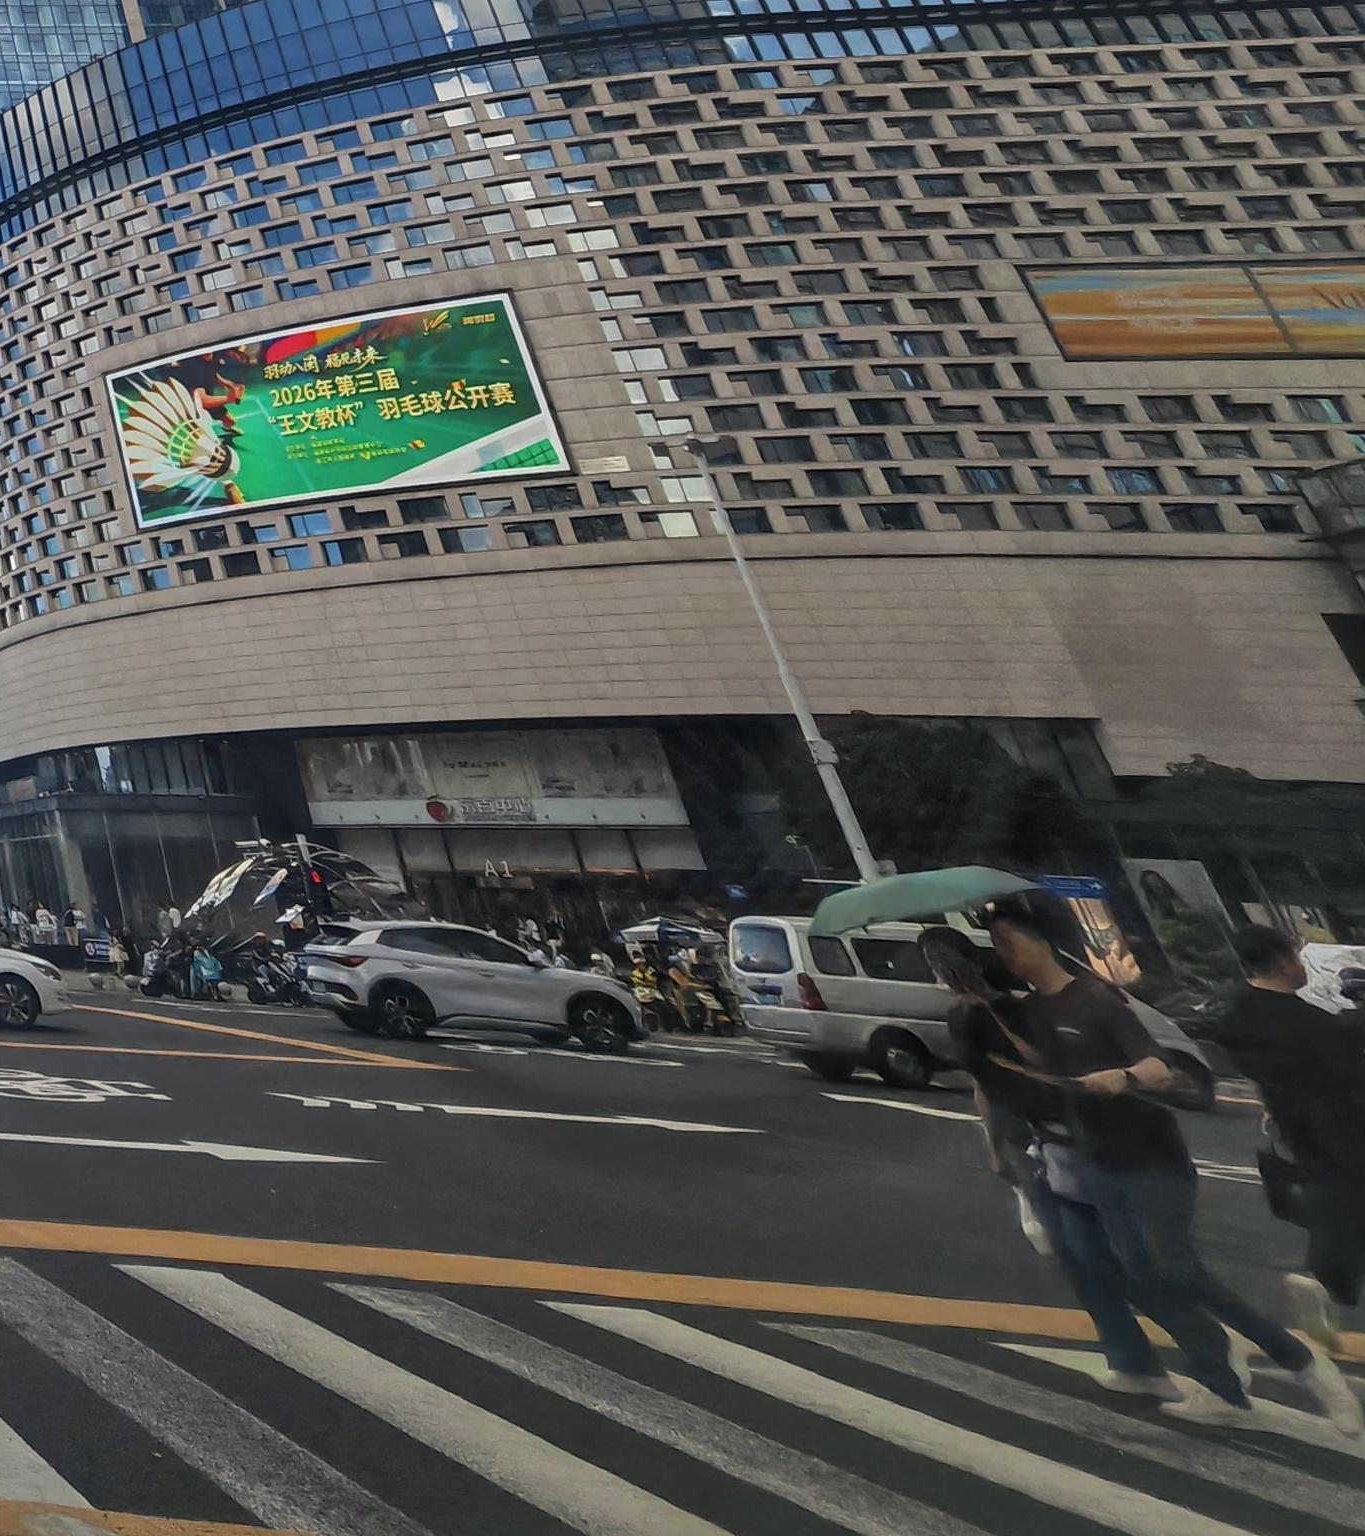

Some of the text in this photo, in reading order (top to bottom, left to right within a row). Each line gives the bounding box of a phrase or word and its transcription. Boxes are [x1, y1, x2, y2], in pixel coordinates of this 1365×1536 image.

[269, 367, 402, 408] 2026年第三届
[375, 381, 517, 421] 羽毛球公开赛
[484, 858, 514, 878] A1
